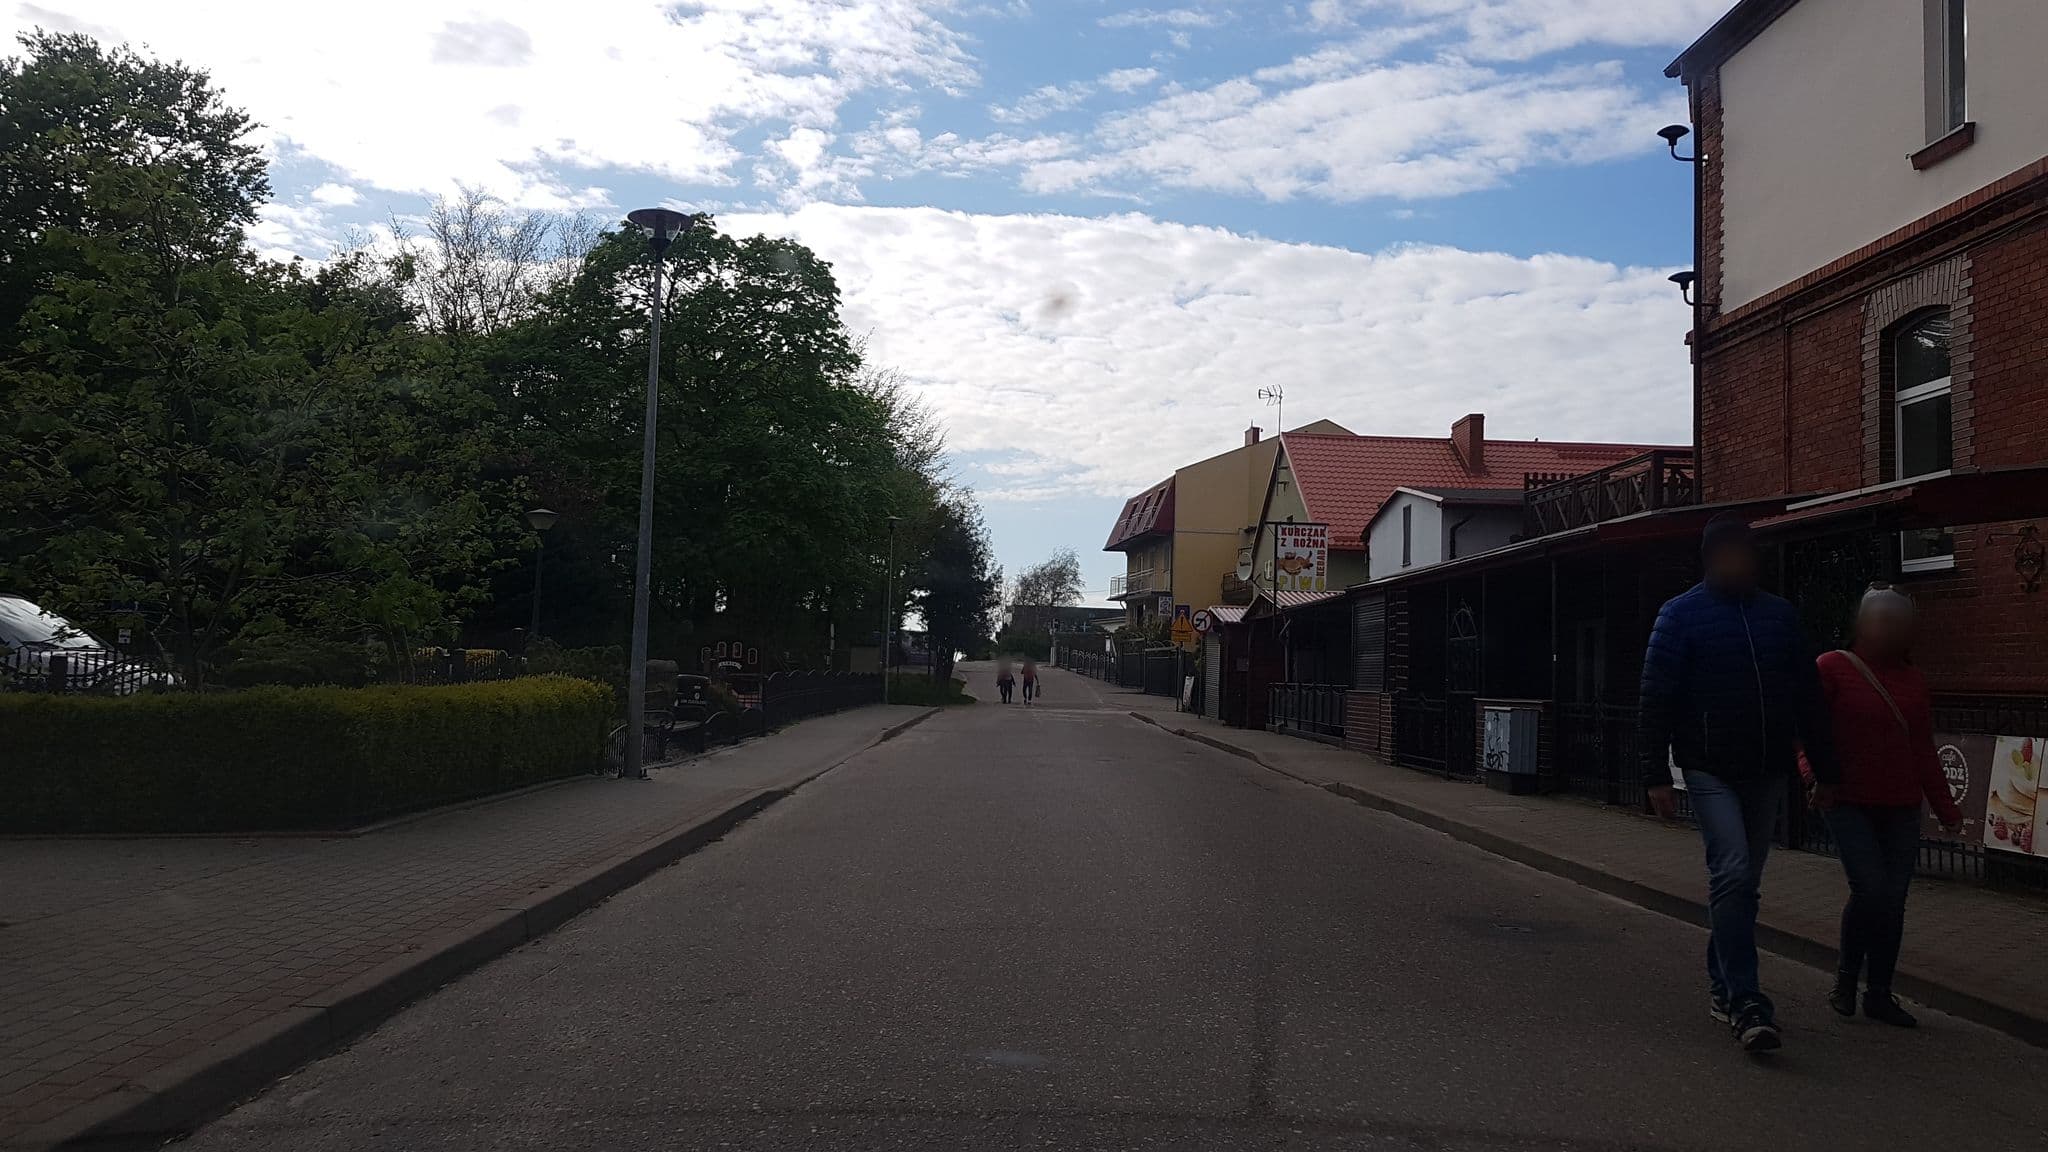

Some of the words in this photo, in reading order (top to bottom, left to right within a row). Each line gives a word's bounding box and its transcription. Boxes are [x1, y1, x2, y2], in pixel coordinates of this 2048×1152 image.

[1281, 527, 1326, 537] KURCZAK
[1281, 538, 1287, 547] Z
[1293, 537, 1326, 548] ROŻNA
